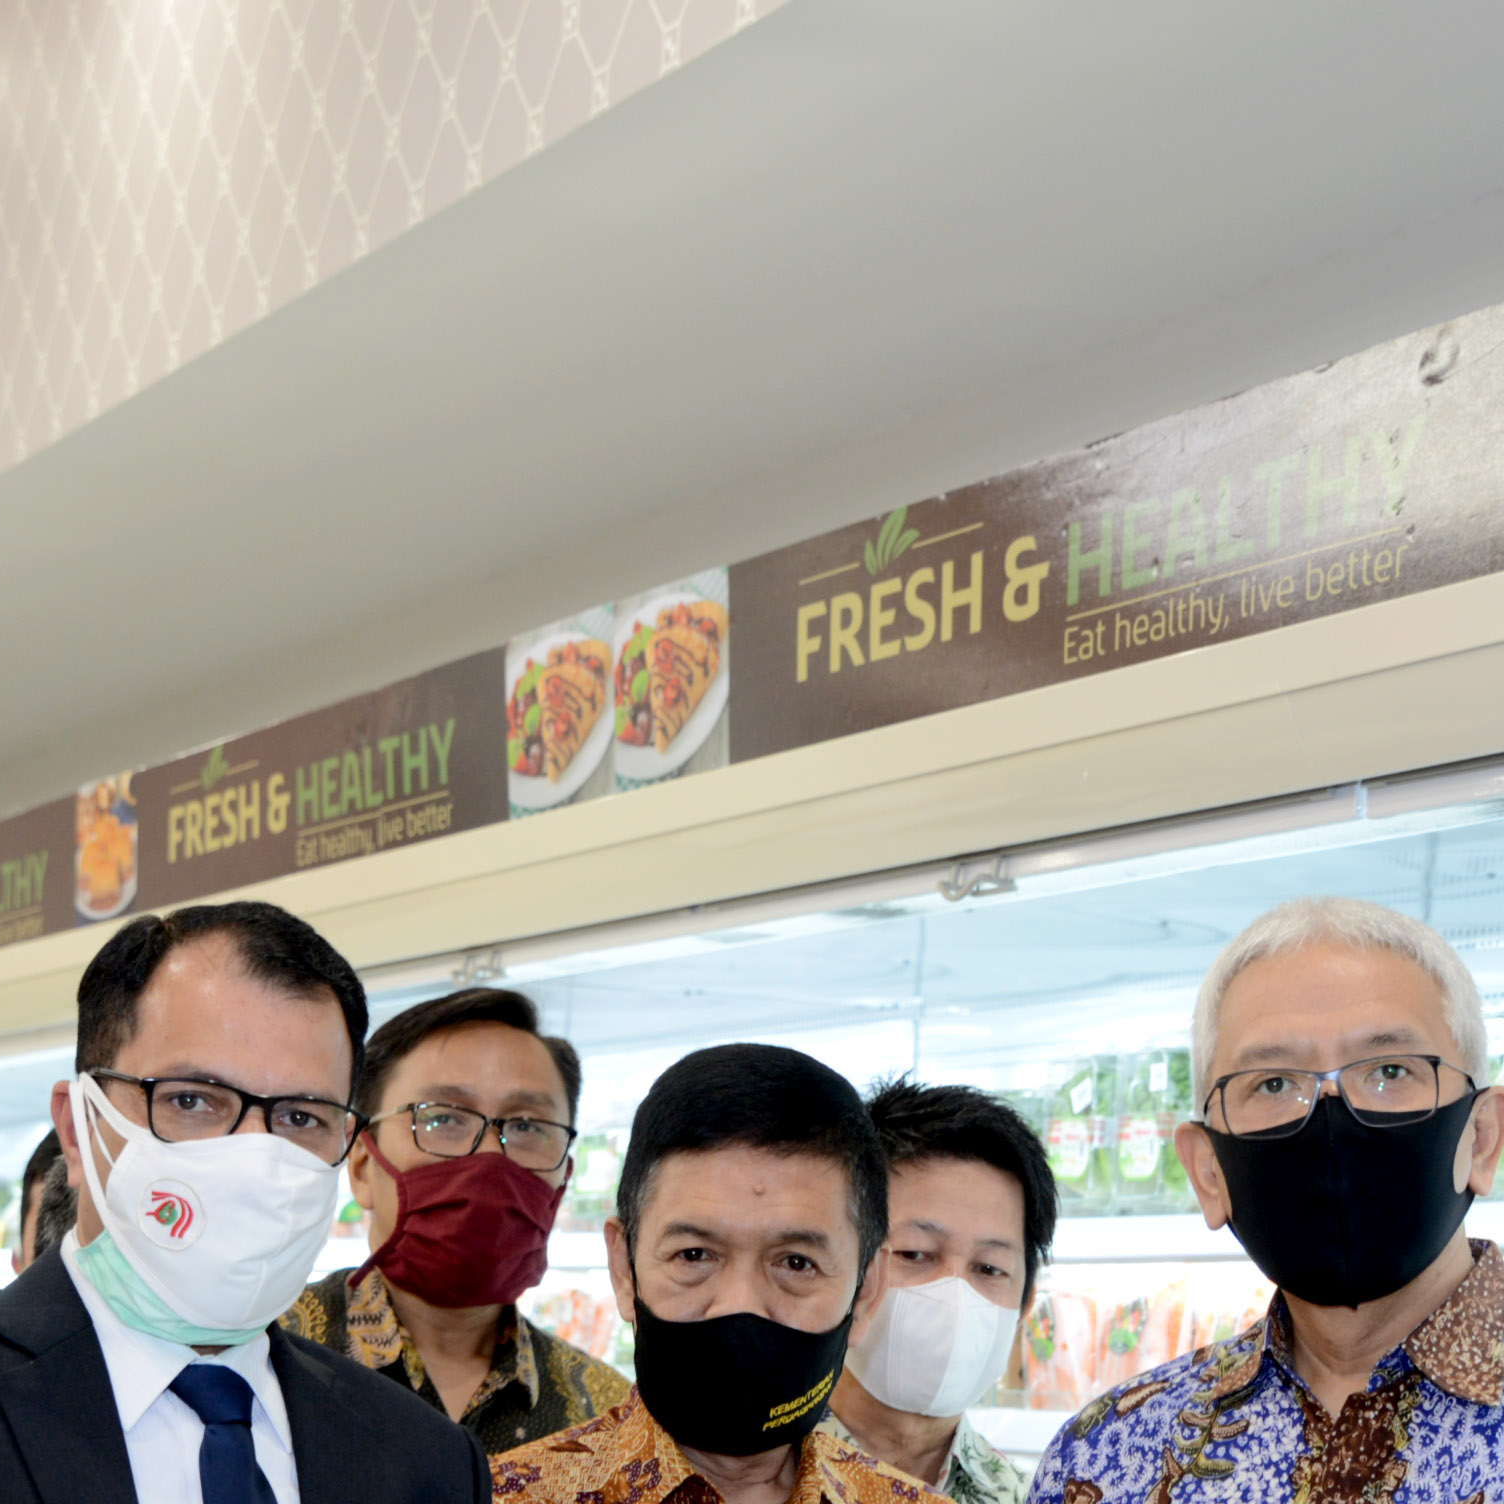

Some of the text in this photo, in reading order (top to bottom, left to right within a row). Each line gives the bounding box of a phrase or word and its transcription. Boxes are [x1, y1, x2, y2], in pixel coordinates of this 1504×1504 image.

[796, 416, 1424, 683] FRESH & HEALTHY
[1063, 542, 1409, 665] Eat healthy, live better
[167, 717, 456, 864] FRESH & HEALTHY
[297, 837, 318, 867] Eat
[377, 815, 404, 848] live
[406, 803, 453, 837] better
